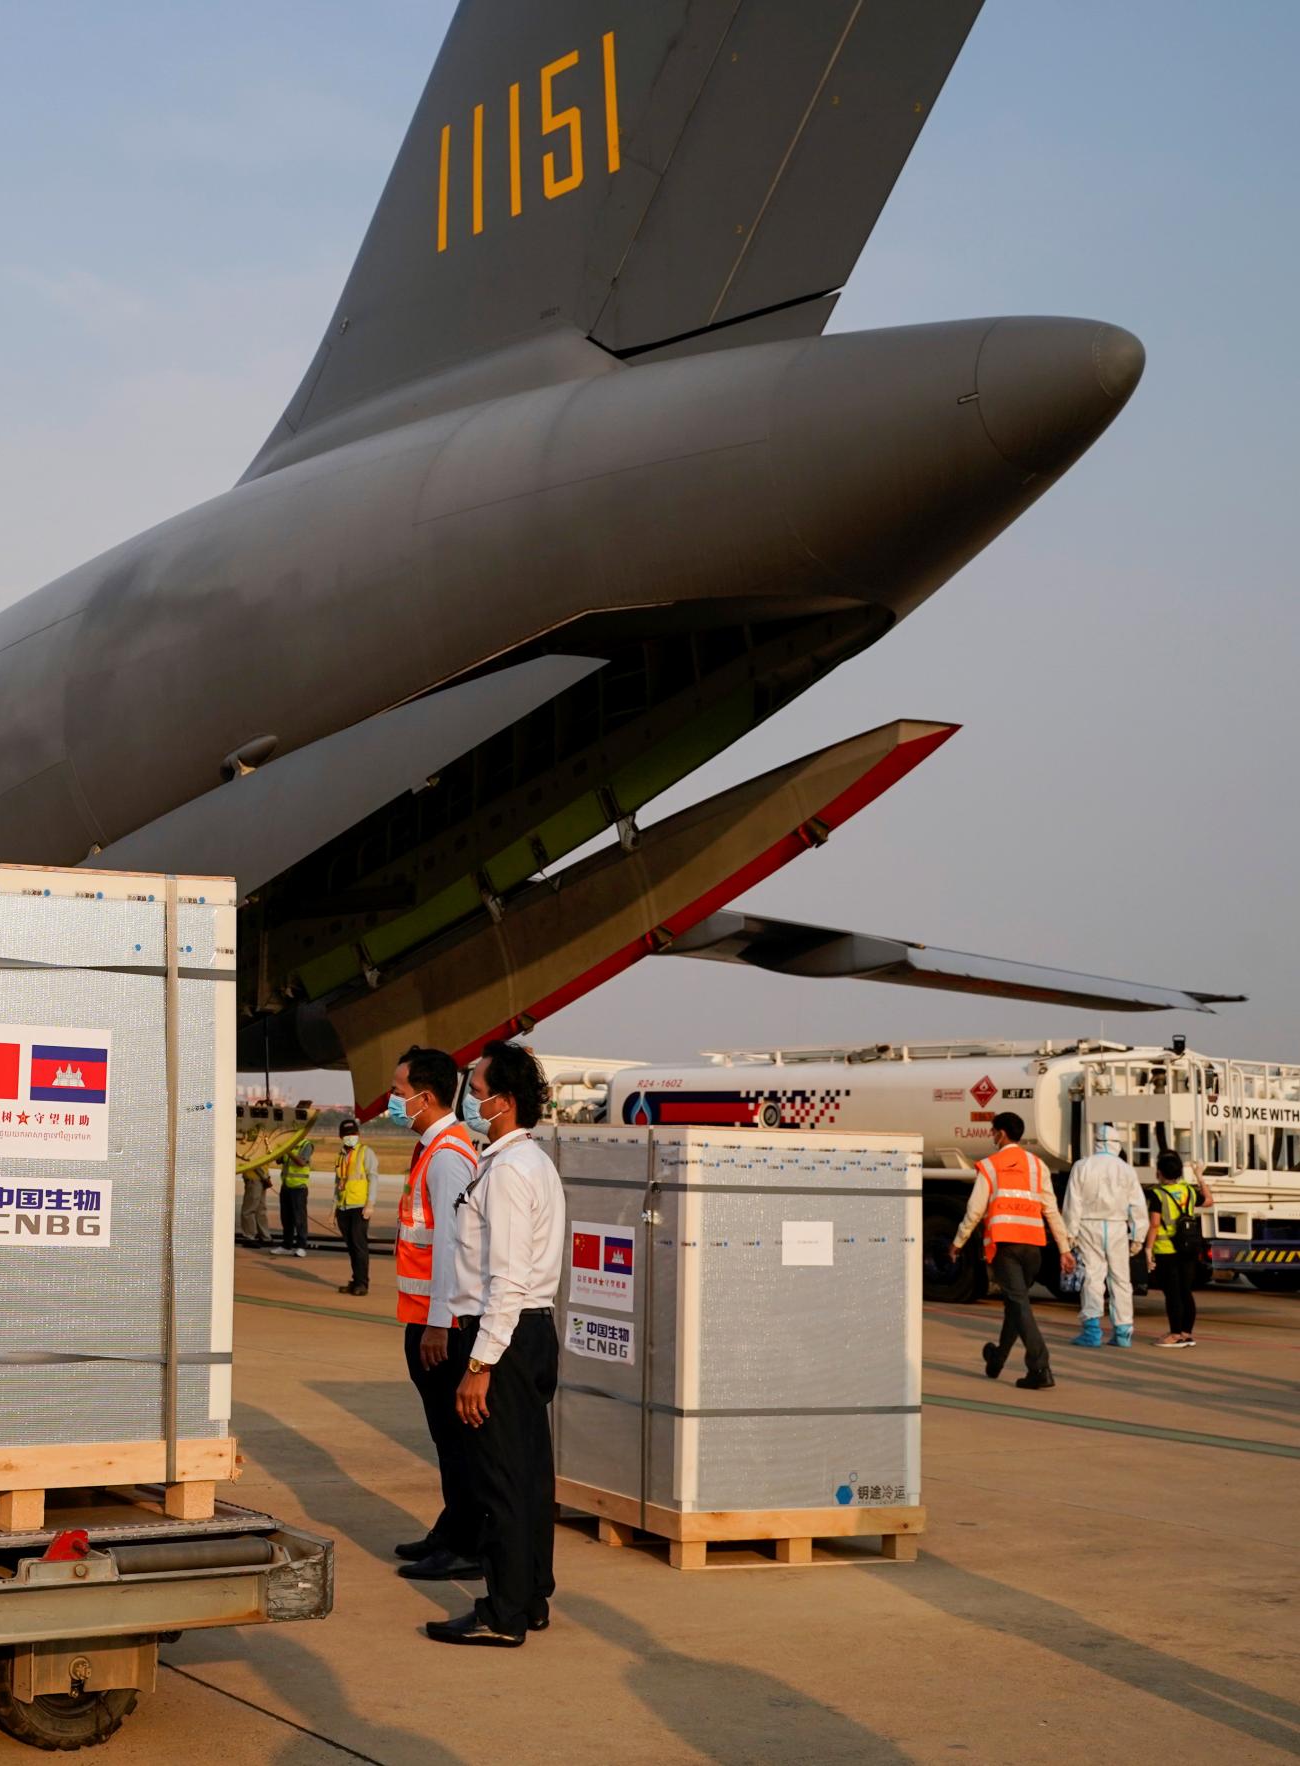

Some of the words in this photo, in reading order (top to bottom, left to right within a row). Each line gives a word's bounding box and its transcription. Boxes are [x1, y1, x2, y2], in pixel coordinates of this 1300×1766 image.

[437, 31, 621, 253] 11151
[1007, 1089, 1021, 1098] JET
[33, 1112, 90, 1127] 守望相助
[1223, 1105, 1268, 1121] SMOKE
[586, 1321, 630, 1343] 中国生物
[586, 1337, 629, 1359] CNBG
